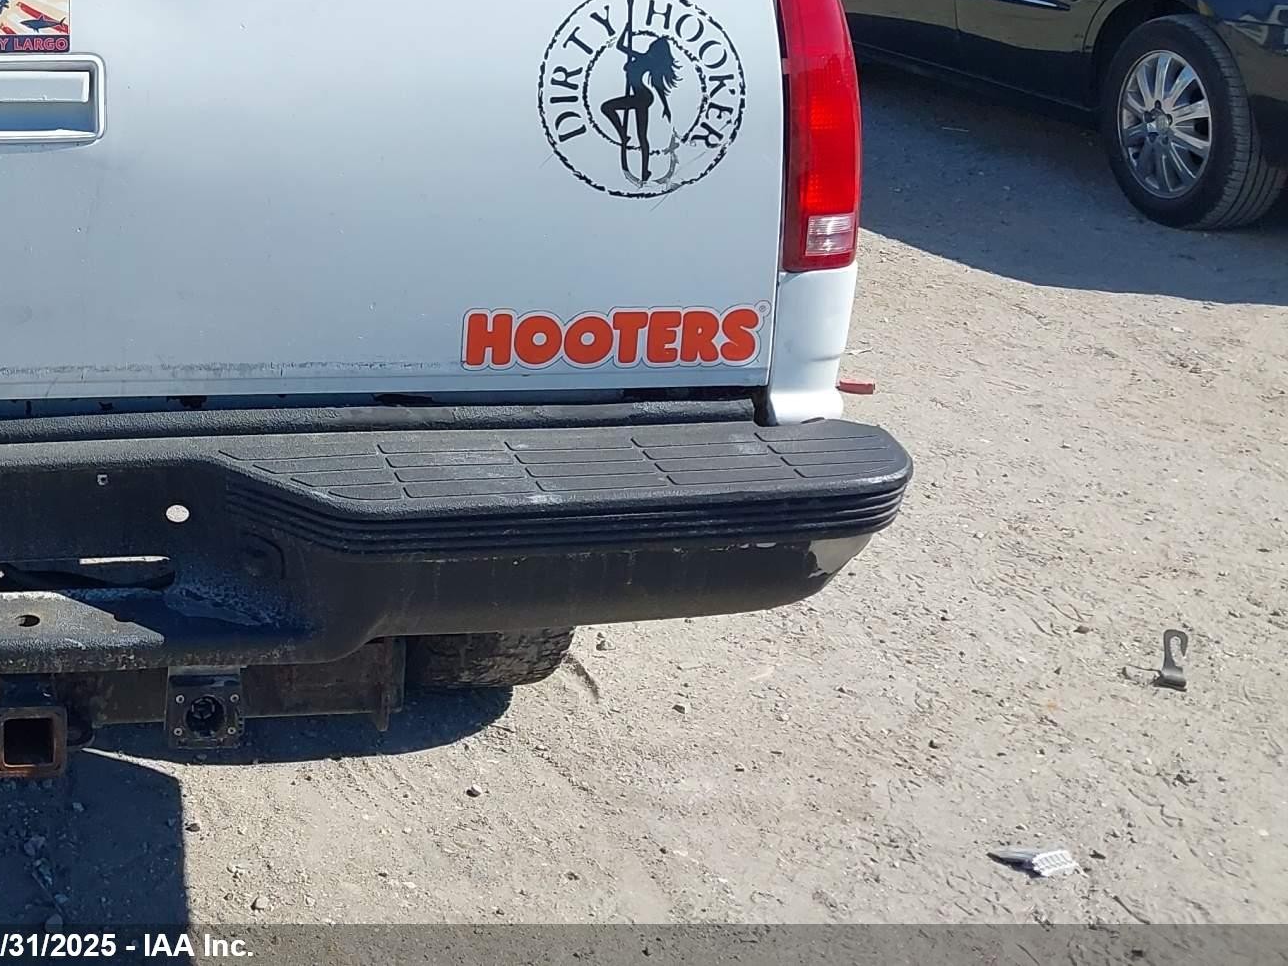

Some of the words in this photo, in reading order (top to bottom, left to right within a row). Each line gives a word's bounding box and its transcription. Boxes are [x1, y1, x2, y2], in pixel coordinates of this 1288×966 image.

[13, 37, 68, 51] LARGO
[549, 5, 616, 143] DIRTY
[645, 0, 736, 149] HOOKER
[465, 308, 759, 366] HOOTERS
